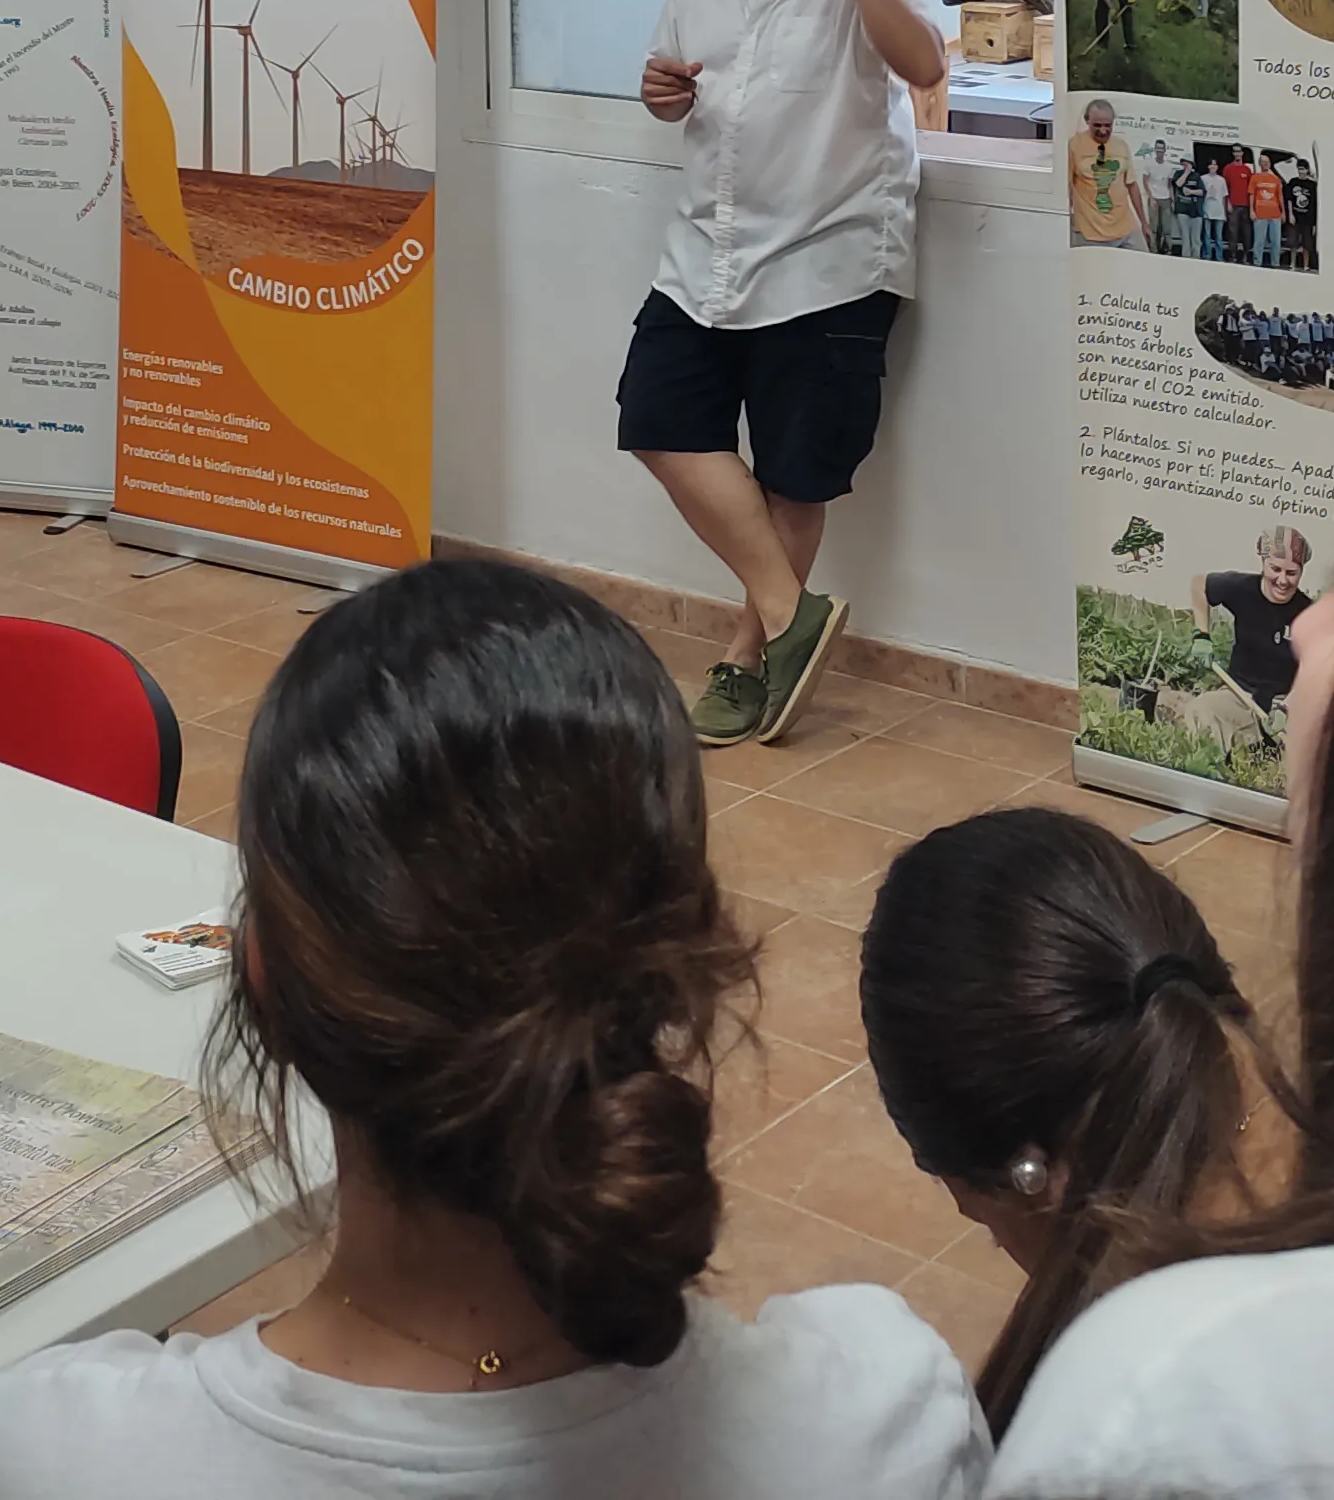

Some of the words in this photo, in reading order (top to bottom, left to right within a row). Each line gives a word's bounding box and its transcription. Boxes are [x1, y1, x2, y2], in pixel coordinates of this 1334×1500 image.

[1253, 58, 1302, 76] Todos
[1309, 61, 1331, 78] los
[228, 267, 311, 309] CAMBIO
[317, 238, 425, 311] CLIMÁTICO
[1078, 294, 1093, 305] 1.
[1100, 293, 1150, 313] Calcula
[1156, 302, 1179, 318] tus
[1077, 312, 1148, 332] emisiones
[1153, 324, 1162, 338] y
[1078, 331, 1136, 349] cuántos
[1141, 339, 1193, 358] árboles
[123, 349, 166, 366] Energías
[167, 356, 223, 375] renovables
[123, 366, 128, 378] y
[129, 366, 143, 378] no
[144, 368, 201, 388] renovables
[1077, 352, 1105, 363] son
[1111, 355, 1183, 376] necesarios
[1189, 367, 1225, 383] para
[1078, 368, 1139, 388] depurar
[1144, 377, 1156, 391] el
[1162, 380, 1195, 397] CO2
[1202, 389, 1264, 409] emitido.
[123, 396, 164, 414] Impacto
[165, 401, 181, 416] del
[183, 406, 221, 422] cambio
[223, 411, 271, 432] climático
[1080, 388, 1127, 404] Utiliza
[1132, 395, 1187, 415] nuestro
[1194, 406, 1276, 430] calculador.
[122, 414, 128, 427] y
[129, 415, 181, 433] reducción
[181, 421, 195, 434] de
[196, 424, 249, 444] emisiones
[1177, 440, 1193, 455] Si
[1197, 446, 1215, 458] no
[123, 443, 175, 462] Protección
[178, 452, 191, 466] de
[192, 453, 202, 468] la
[204, 456, 275, 482] biodiversidad
[276, 472, 283, 486] y
[285, 469, 301, 487] los
[303, 475, 369, 499] ecosistemas
[1081, 442, 1094, 458] lo
[1101, 444, 1161, 469] hacemos
[1167, 460, 1193, 476] por
[1220, 468, 1297, 496] plantarlo,
[123, 474, 211, 502] Aprovechamiento
[213, 489, 266, 513] sostenible
[268, 501, 281, 515] de
[283, 504, 300, 519] los
[301, 509, 348, 528] recursos
[349, 515, 403, 539] naturales
[1081, 464, 1139, 485] regarlo,
[1143, 476, 1244, 504] garantizando
[1249, 493, 1265, 506] su
[1272, 496, 1328, 522] óptimo
